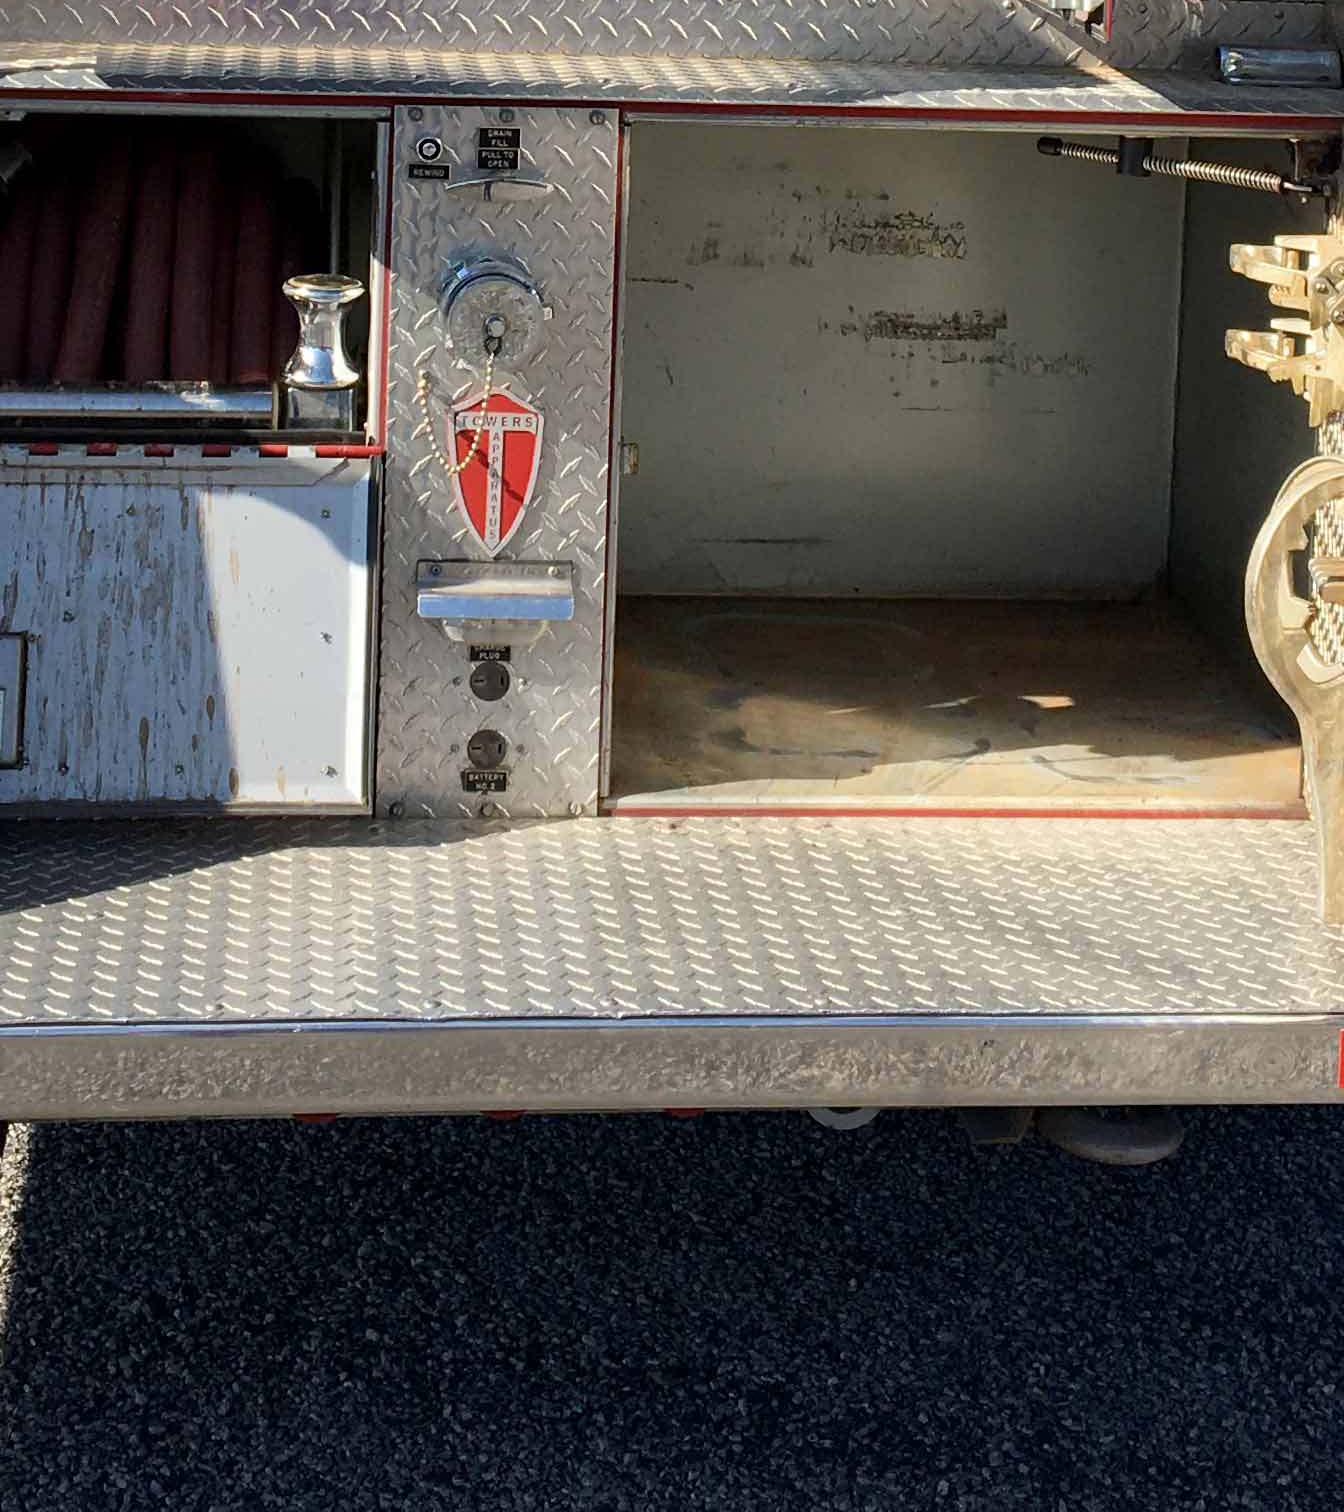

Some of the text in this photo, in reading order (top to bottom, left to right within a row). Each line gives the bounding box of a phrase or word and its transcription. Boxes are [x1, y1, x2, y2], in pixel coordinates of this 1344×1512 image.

[481, 151, 501, 159] PULL
[488, 160, 510, 168] OPEN
[461, 416, 534, 428] TOWERS
[489, 431, 500, 539] APPARATUS
[468, 774, 504, 782] BATTERY
